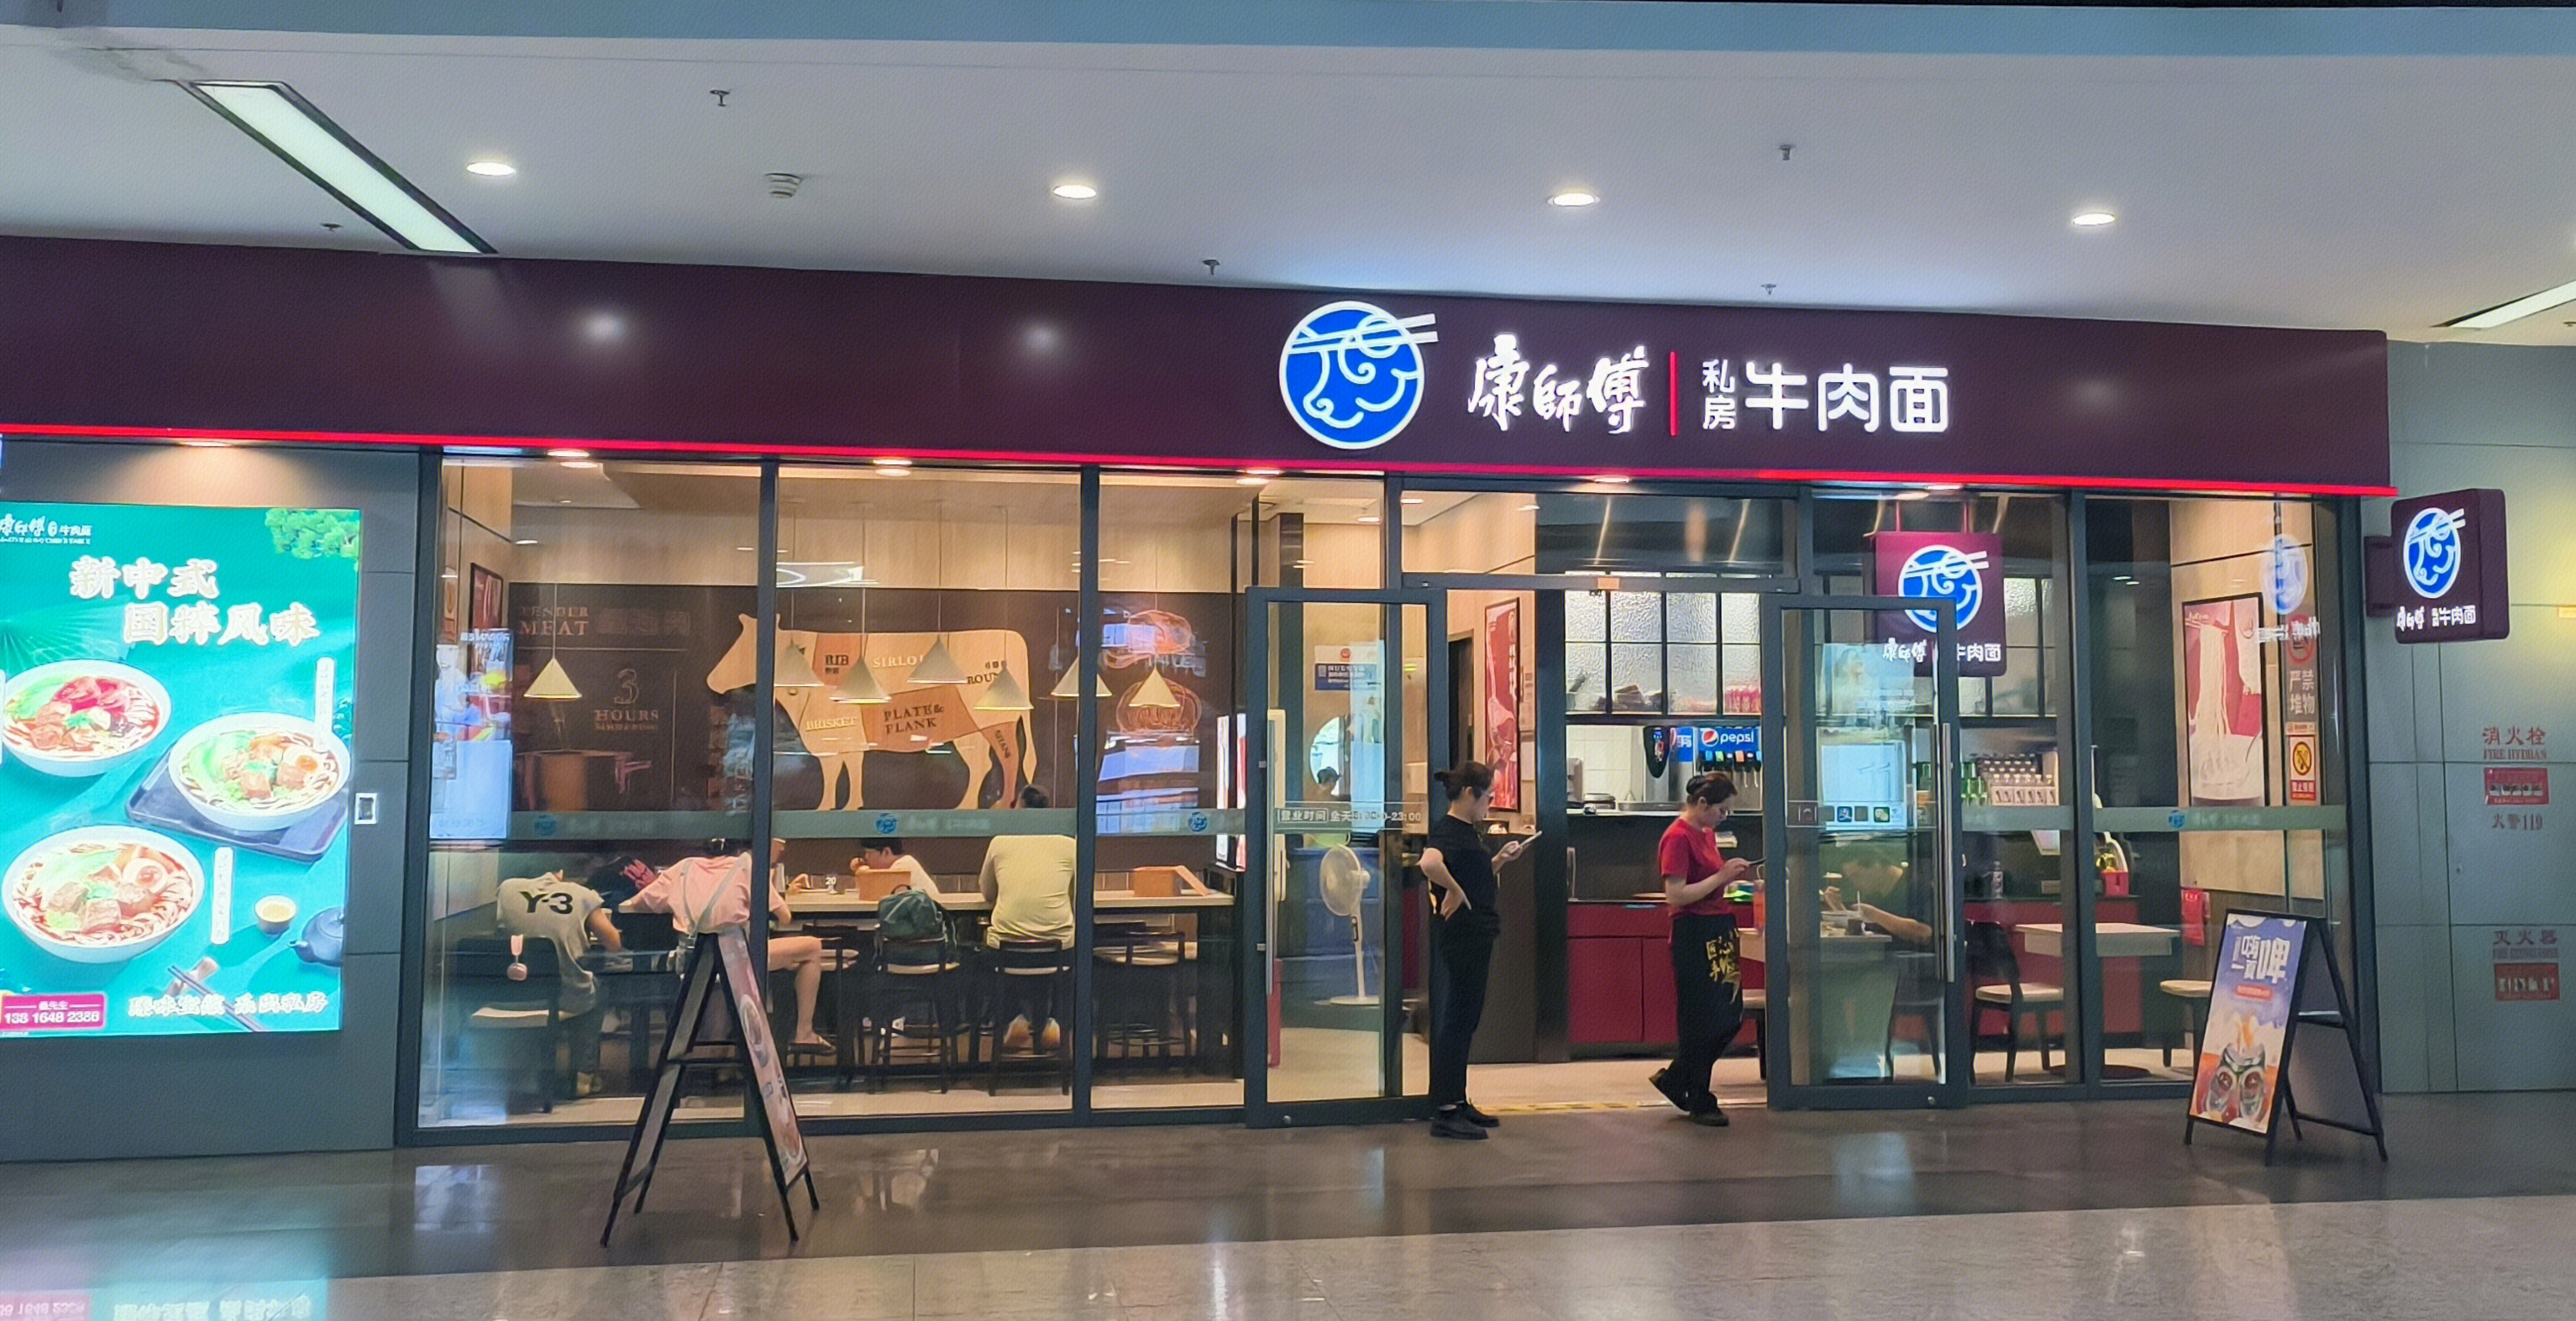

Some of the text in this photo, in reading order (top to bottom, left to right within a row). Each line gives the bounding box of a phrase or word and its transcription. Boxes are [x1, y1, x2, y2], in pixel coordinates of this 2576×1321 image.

[1467, 334, 1949, 434] 康師傅 私房 牛肉面
[70, 555, 219, 599] 新中式
[123, 600, 320, 646] 国粹风味
[519, 620, 590, 636] MEAT
[825, 654, 849, 666] RIB
[613, 668, 640, 705] 3
[593, 709, 659, 721] HOURS
[805, 716, 858, 732] BRISKET
[1720, 730, 1755, 745] pepsi
[2482, 725, 2547, 746] 消火栓
[518, 891, 573, 915] Y-3
